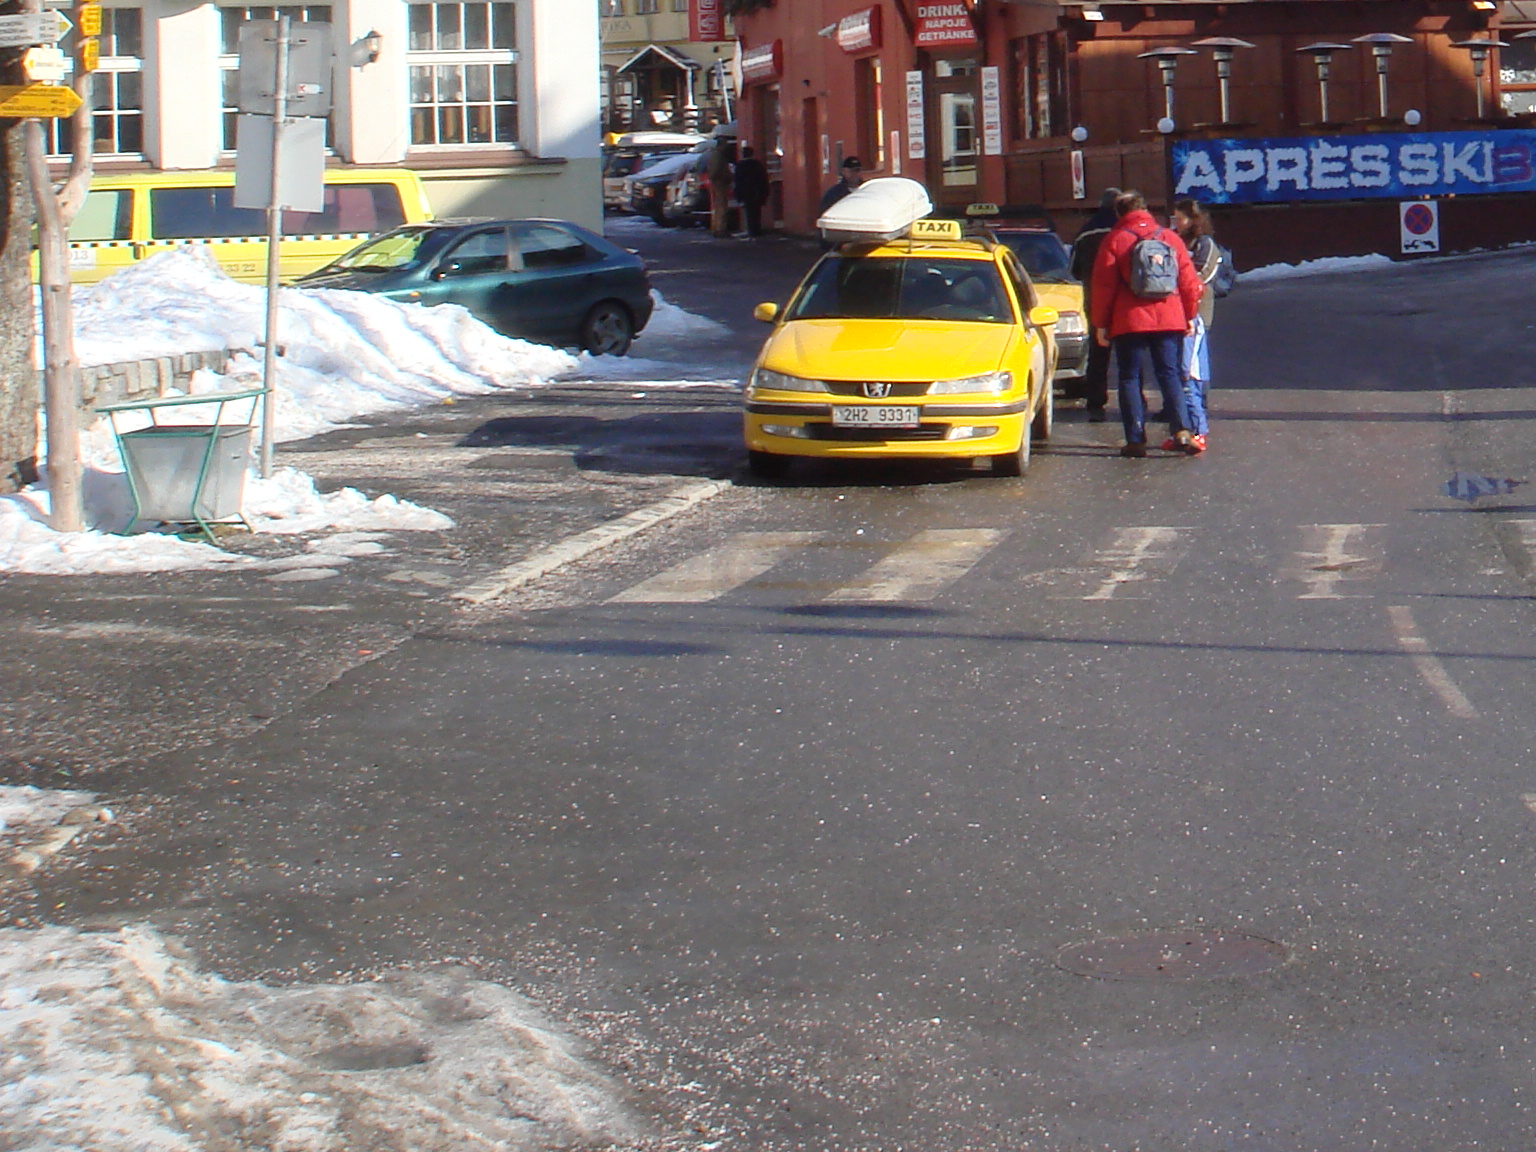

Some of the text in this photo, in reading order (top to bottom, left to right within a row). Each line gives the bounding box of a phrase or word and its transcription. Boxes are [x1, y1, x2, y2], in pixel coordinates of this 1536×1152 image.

[1174, 139, 1391, 195] APRÈS
[1398, 141, 1495, 186] SKI
[917, 222, 953, 233] TAXI
[844, 408, 912, 422] 2H2 9331
